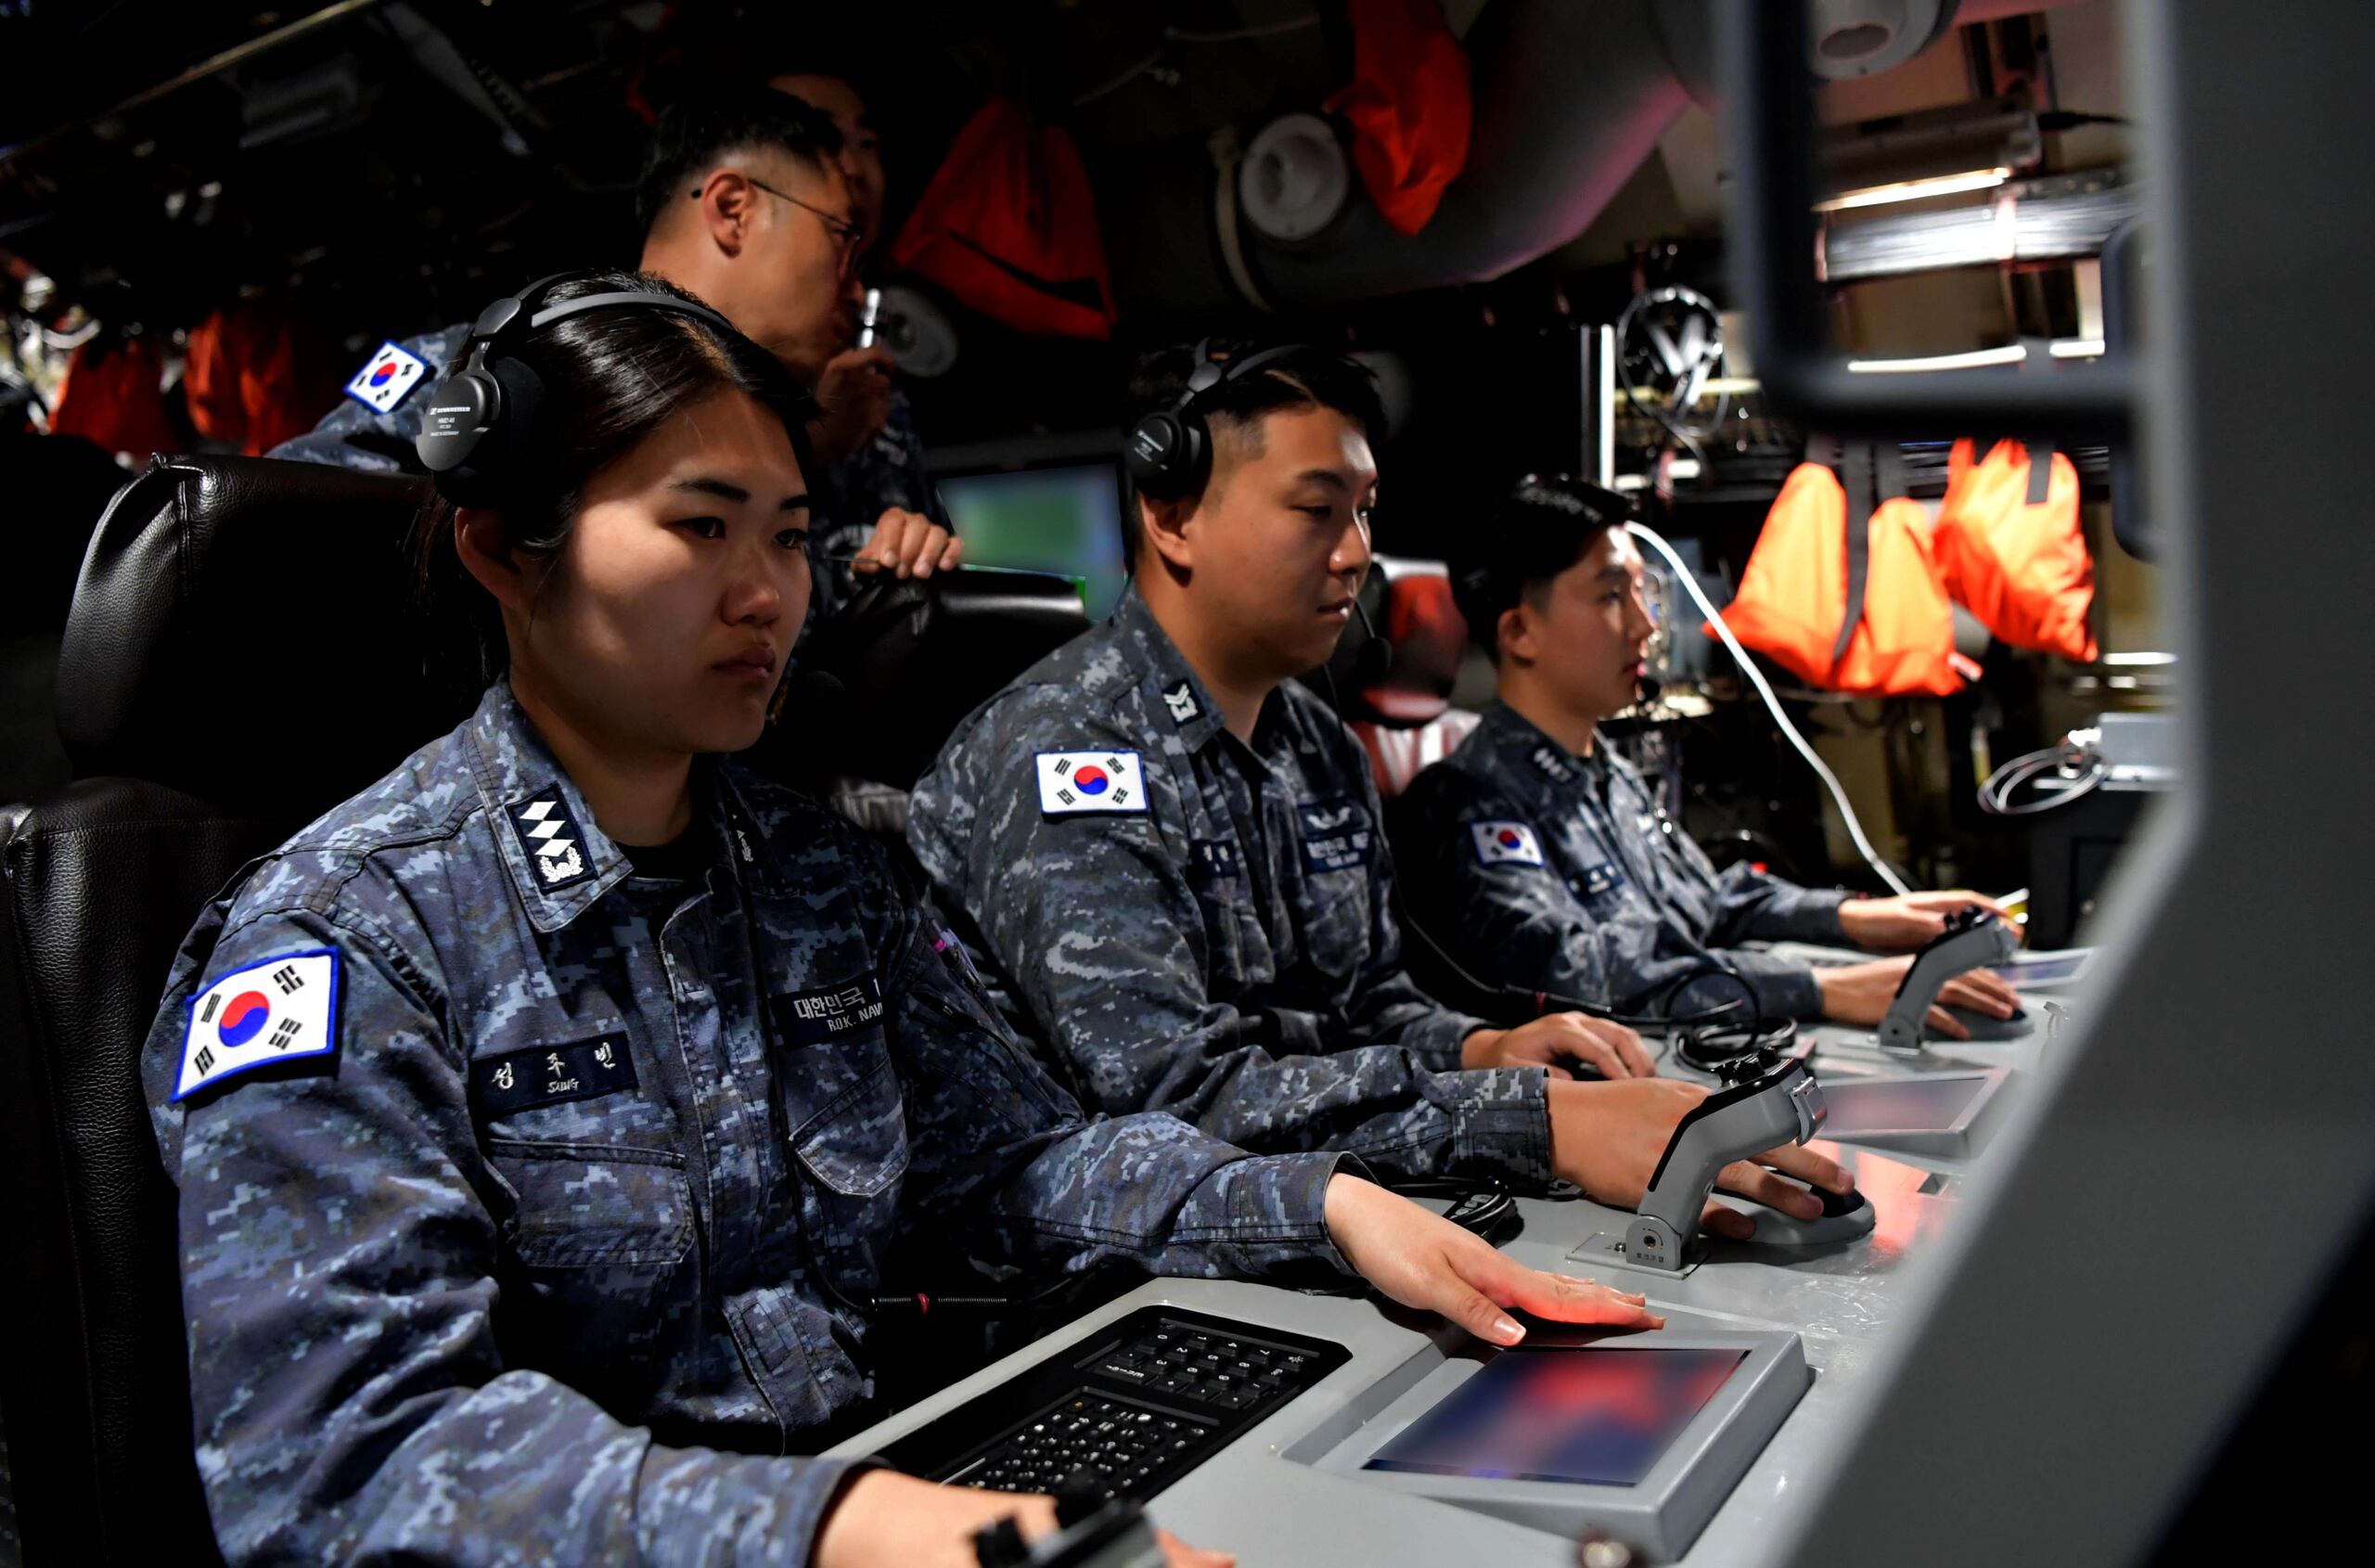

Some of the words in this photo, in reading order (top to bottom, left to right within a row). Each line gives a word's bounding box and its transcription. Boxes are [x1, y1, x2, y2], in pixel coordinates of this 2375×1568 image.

[793, 986, 866, 1019] 대한민국
[546, 1052, 566, 1078] 주
[594, 1041, 616, 1069] 빈
[546, 1078, 579, 1093] SUNG
